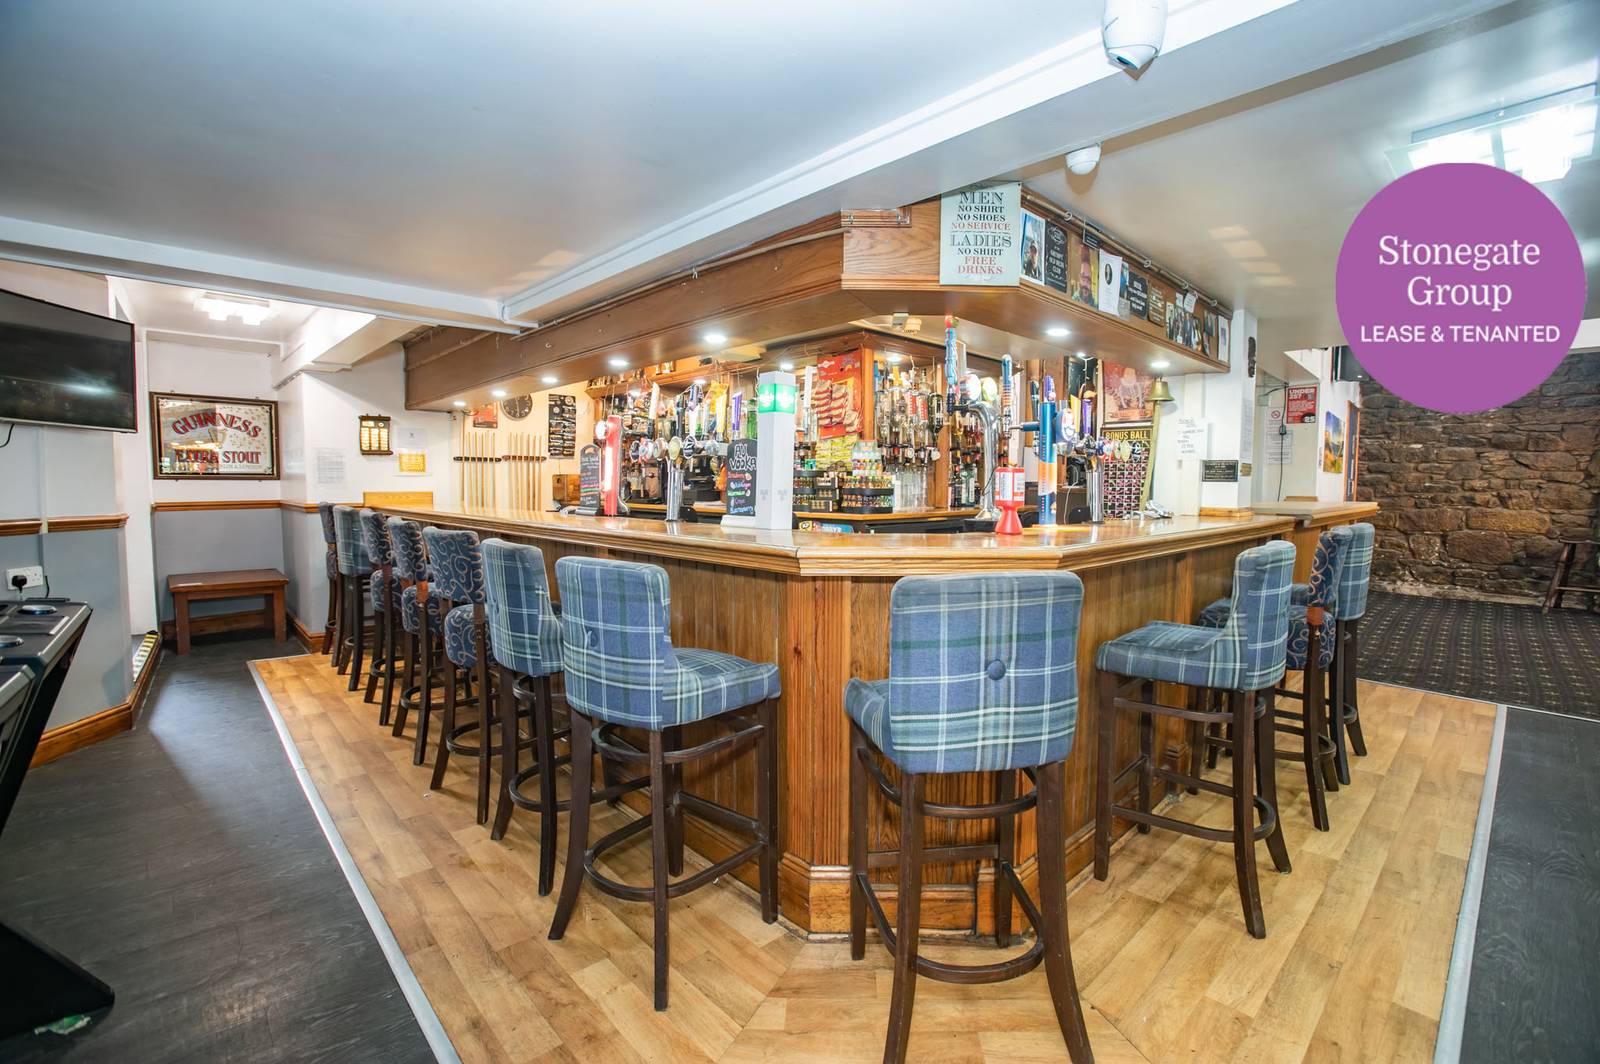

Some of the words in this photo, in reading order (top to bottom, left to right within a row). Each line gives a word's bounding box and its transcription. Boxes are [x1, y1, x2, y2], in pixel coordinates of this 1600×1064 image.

[959, 191, 1004, 204] MEN
[974, 205, 1005, 213] SHIRT
[972, 214, 1006, 222] SHOES
[967, 222, 1011, 231] SERVICE
[950, 234, 1012, 248] LADIES
[973, 248, 1004, 256] SHIRT
[964, 256, 997, 265] FREE
[958, 265, 1003, 274] DRINKS
[171, 411, 262, 438] GUINNESS
[1105, 431, 1129, 440] BONUS
[1130, 431, 1148, 439] BALL
[222, 450, 262, 464] STOUT
[729, 455, 757, 471] VODKA
